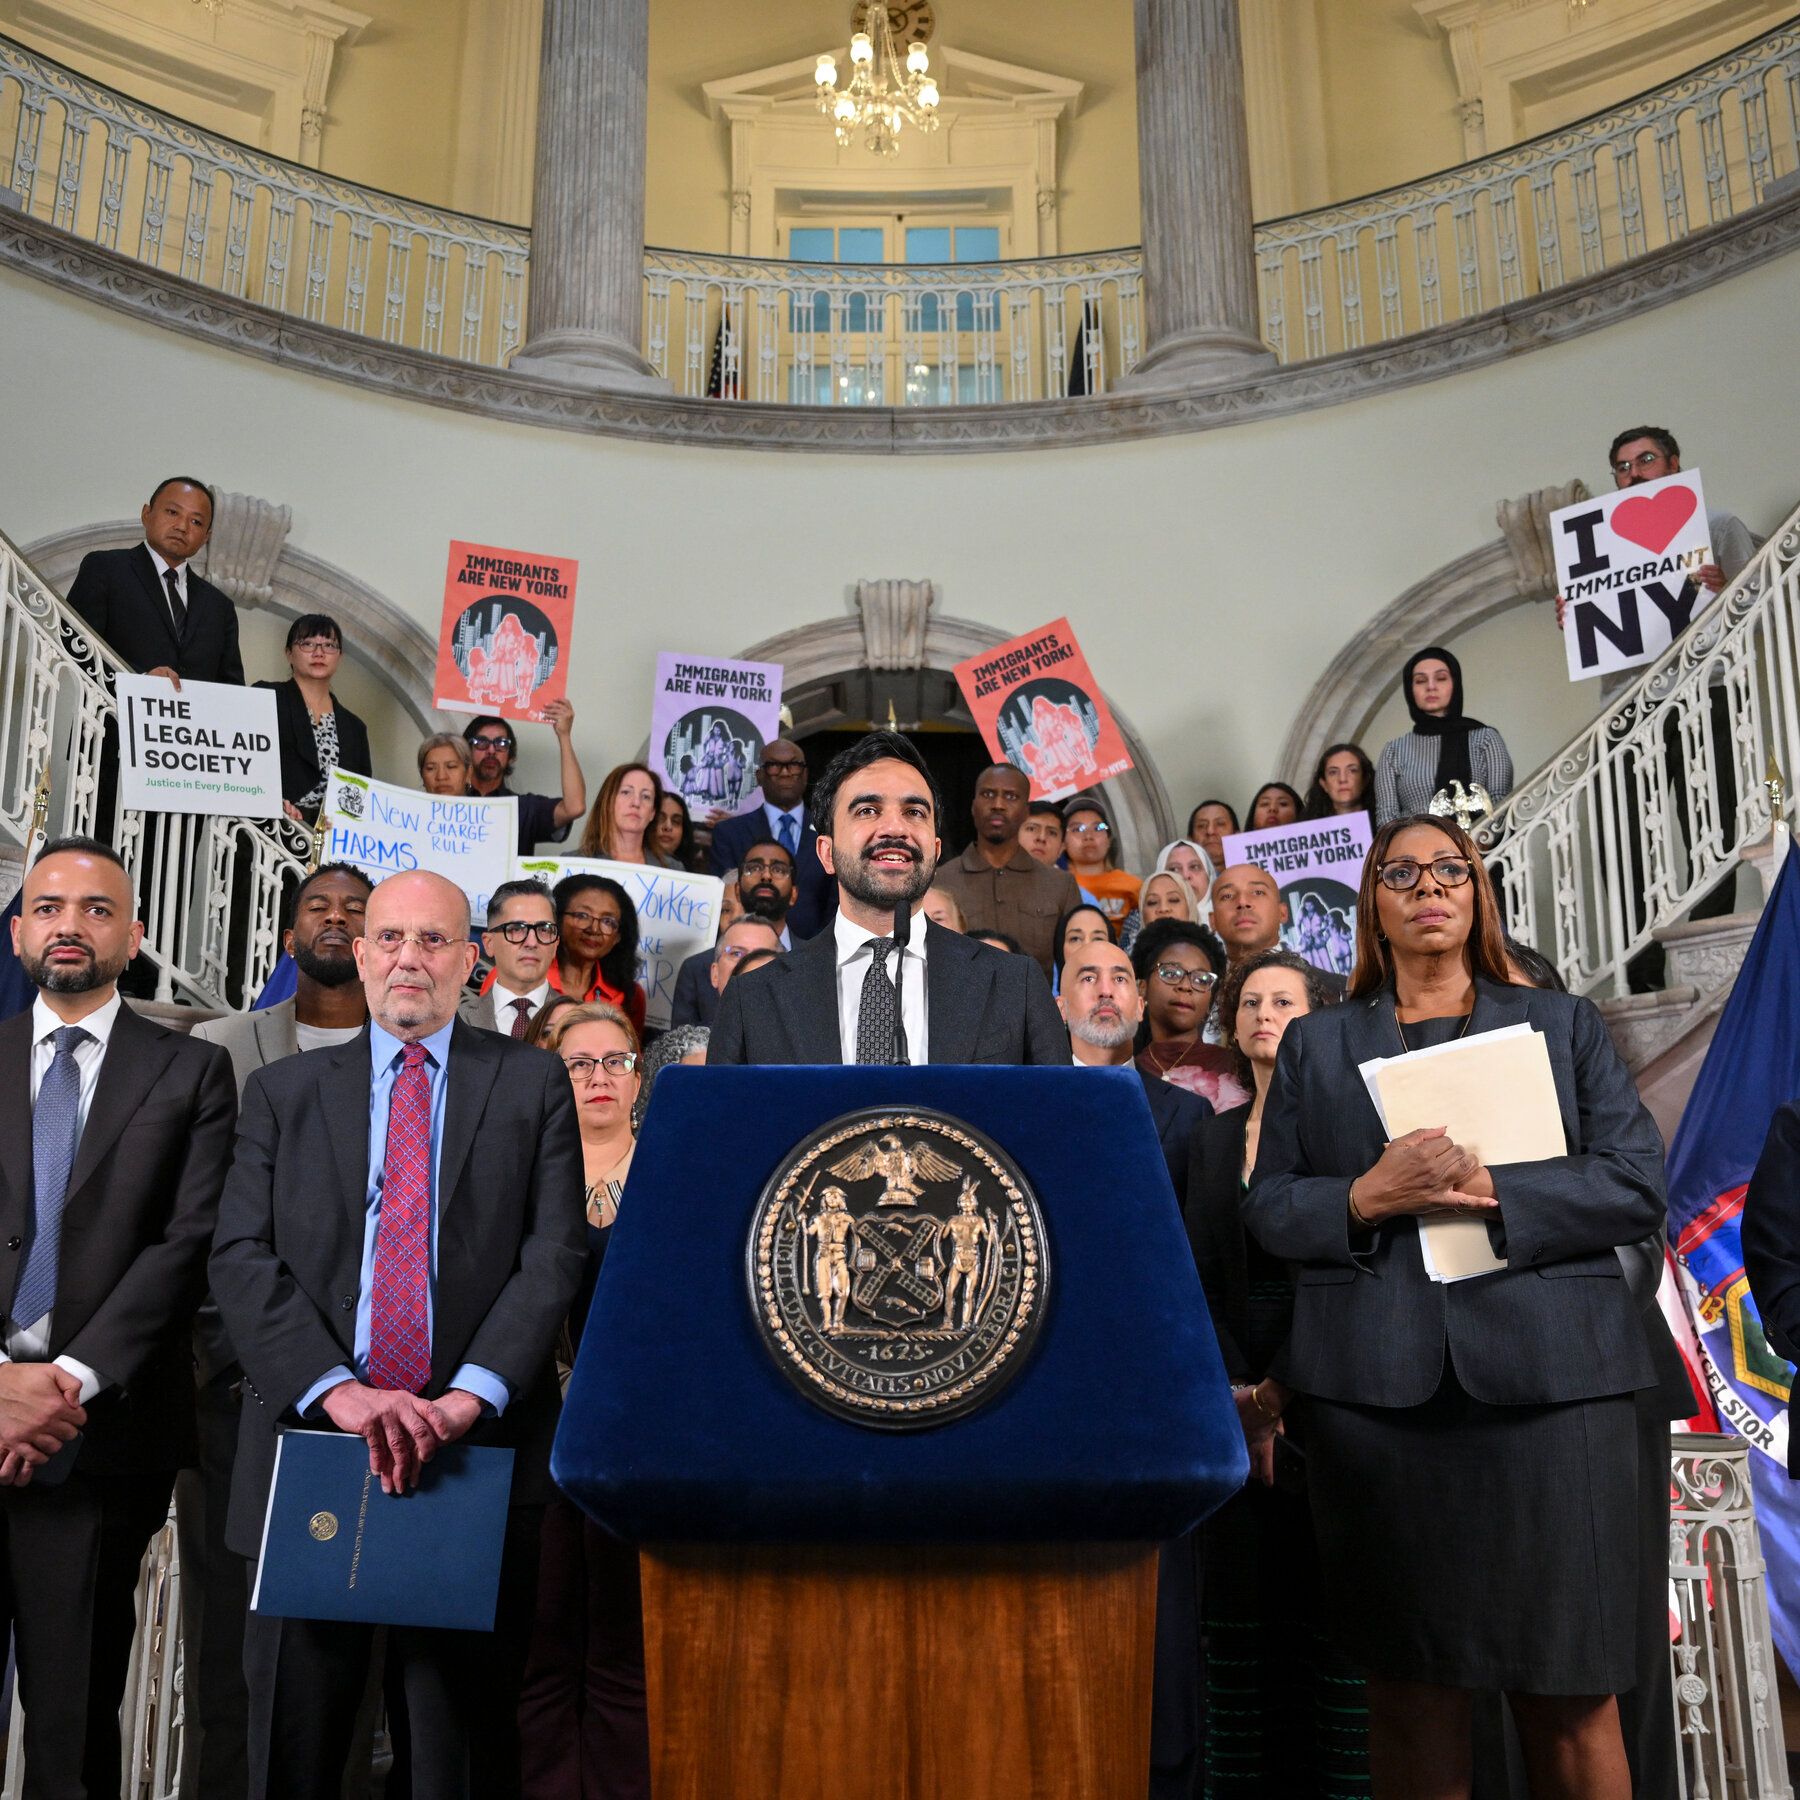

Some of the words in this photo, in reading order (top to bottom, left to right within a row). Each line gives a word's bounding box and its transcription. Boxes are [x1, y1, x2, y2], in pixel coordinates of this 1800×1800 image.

[1563, 508, 1610, 580] I
[466, 554, 560, 582] IMMIGRANTS
[1564, 546, 1710, 602] IMMIGRANT
[458, 570, 484, 586] ARE
[489, 574, 522, 591] NEW
[526, 580, 568, 599] YORK!
[1574, 575, 1700, 669] NY
[972, 634, 1058, 682] IMMIGRANTS
[974, 678, 1001, 698] ARE
[1000, 663, 1032, 686] NEW
[1032, 644, 1074, 671] YORK!
[675, 664, 765, 686] IMMIGRANTS
[665, 678, 692, 694] ARE
[696, 682, 727, 697] NEW
[732, 686, 772, 702] YORK!
[141, 697, 191, 720] THE
[144, 724, 225, 748] LEGAL
[232, 732, 271, 752] AID
[145, 750, 252, 775] SOCIETY
[146, 778, 181, 788] Justice
[183, 780, 192, 788] in
[195, 780, 221, 792] Every
[224, 782, 266, 796] Borough.
[372, 792, 419, 831] New
[432, 801, 493, 825] PUBLIC
[428, 822, 489, 842] CHARGE
[432, 836, 472, 854] RULE
[1245, 828, 1351, 860] IMMIGRANTS
[332, 828, 417, 870] HARMS
[1274, 852, 1308, 873] NEW
[1314, 843, 1364, 866] YORK!
[922, 1347, 977, 1390] NOVI
[982, 1257, 1019, 1350] EBORACI
